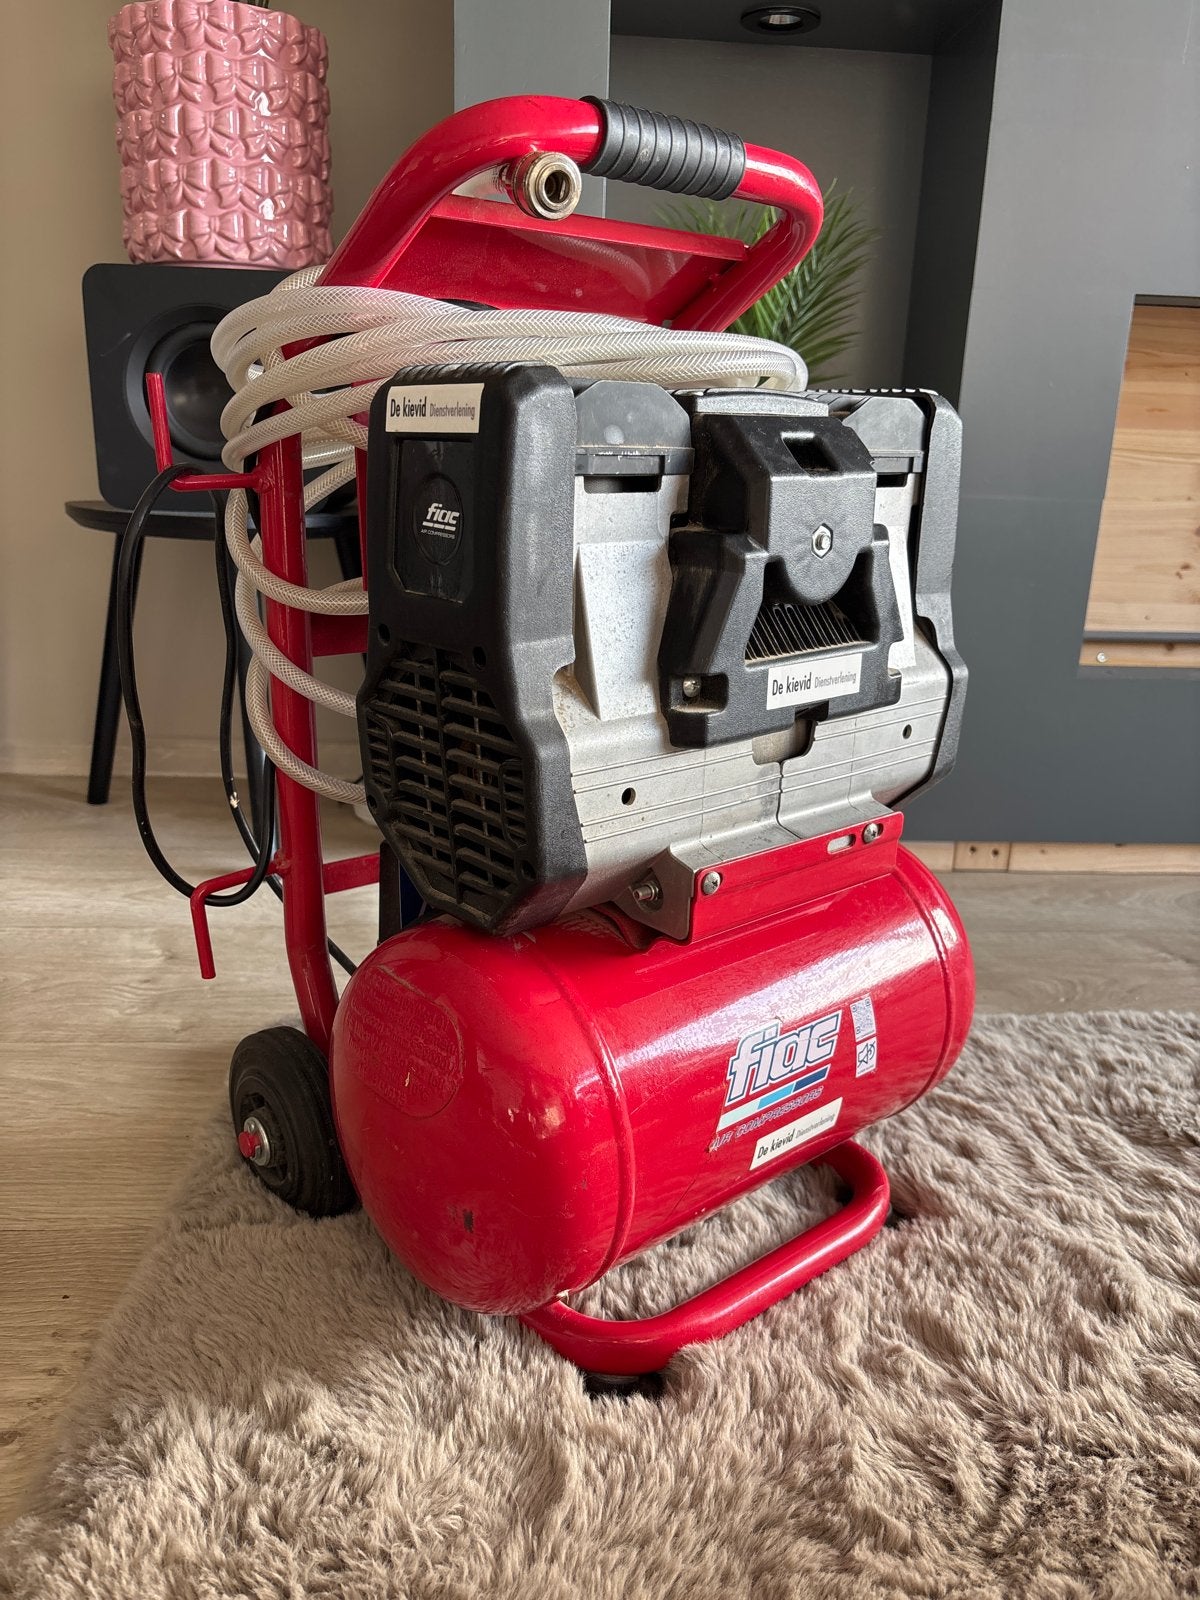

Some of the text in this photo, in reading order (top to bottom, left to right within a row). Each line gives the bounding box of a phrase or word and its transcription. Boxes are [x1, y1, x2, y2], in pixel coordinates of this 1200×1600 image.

[390, 396, 476, 420] De kievid Dienstverlening
[426, 502, 460, 525] fiac
[772, 671, 857, 696] De kievid Dienstverlening
[724, 1009, 842, 1107] fiac
[735, 1085, 824, 1138] COMPRESSORS
[757, 1146, 769, 1159] De
[770, 1128, 796, 1151] kievid
